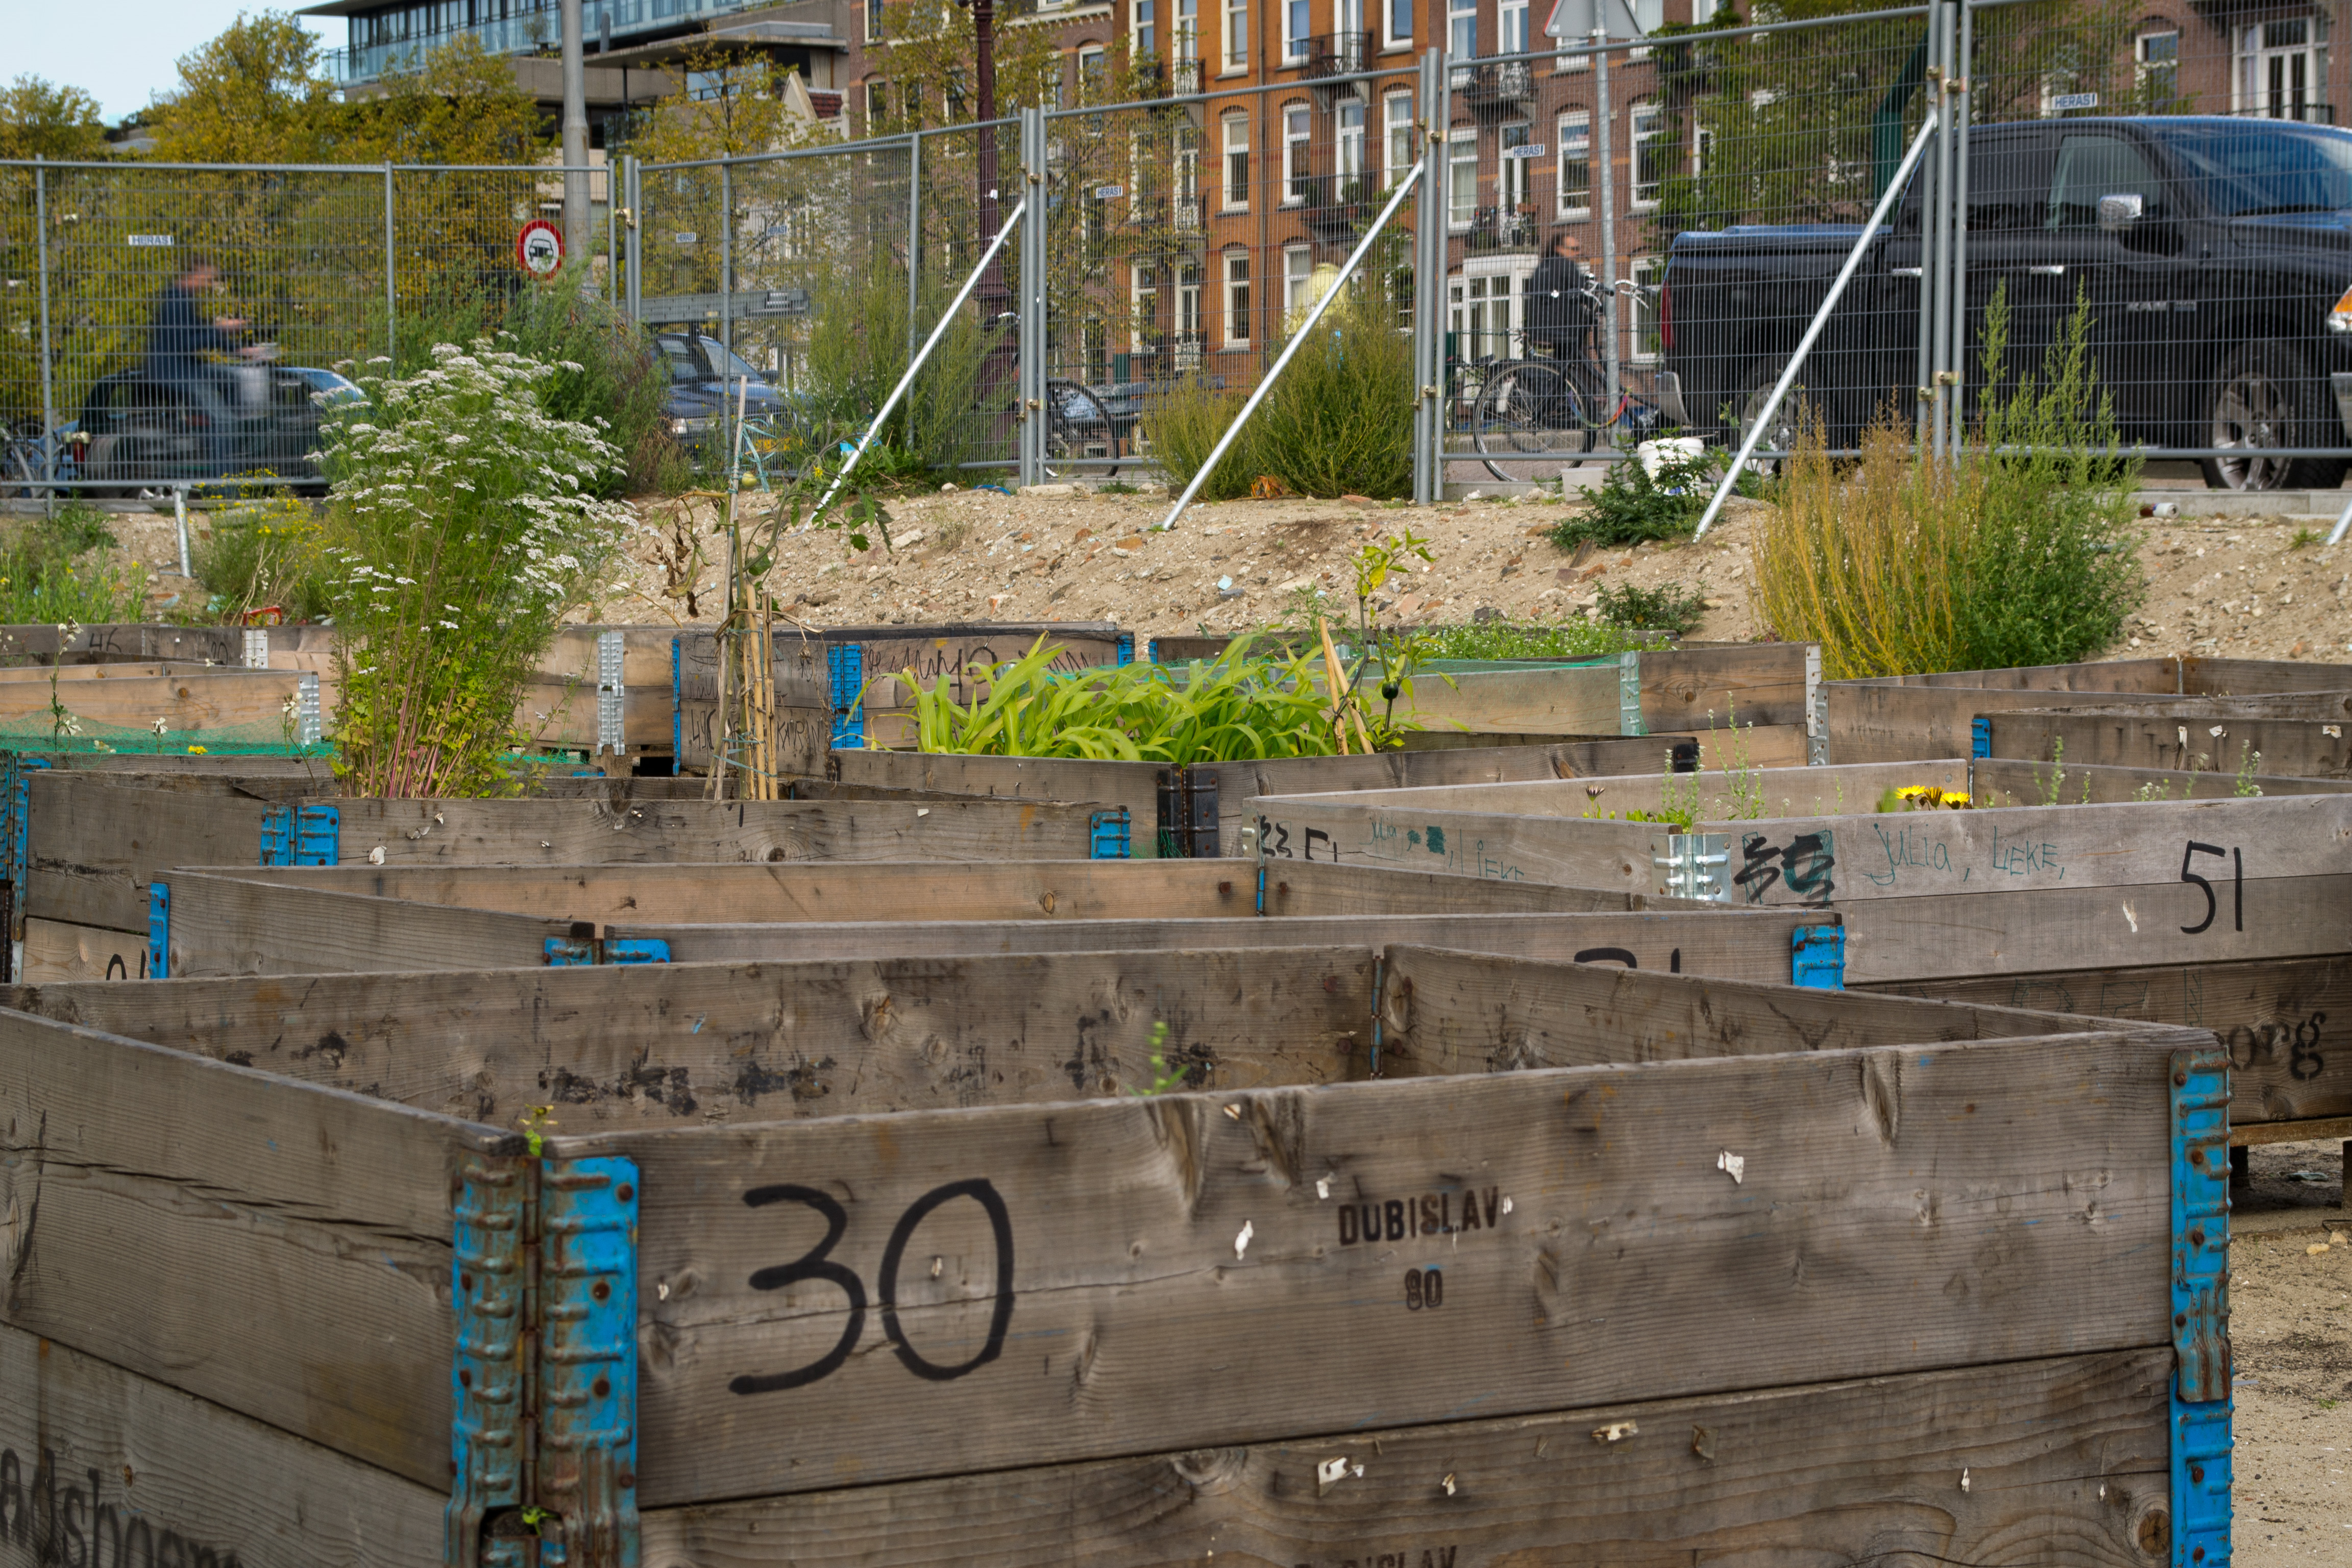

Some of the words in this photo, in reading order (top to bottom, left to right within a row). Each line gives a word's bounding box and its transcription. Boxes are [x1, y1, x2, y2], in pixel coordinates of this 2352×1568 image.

[2180, 840, 2243, 934] 51
[1338, 1186, 1499, 1246] DUBISLAV
[729, 1178, 1016, 1395] 30
